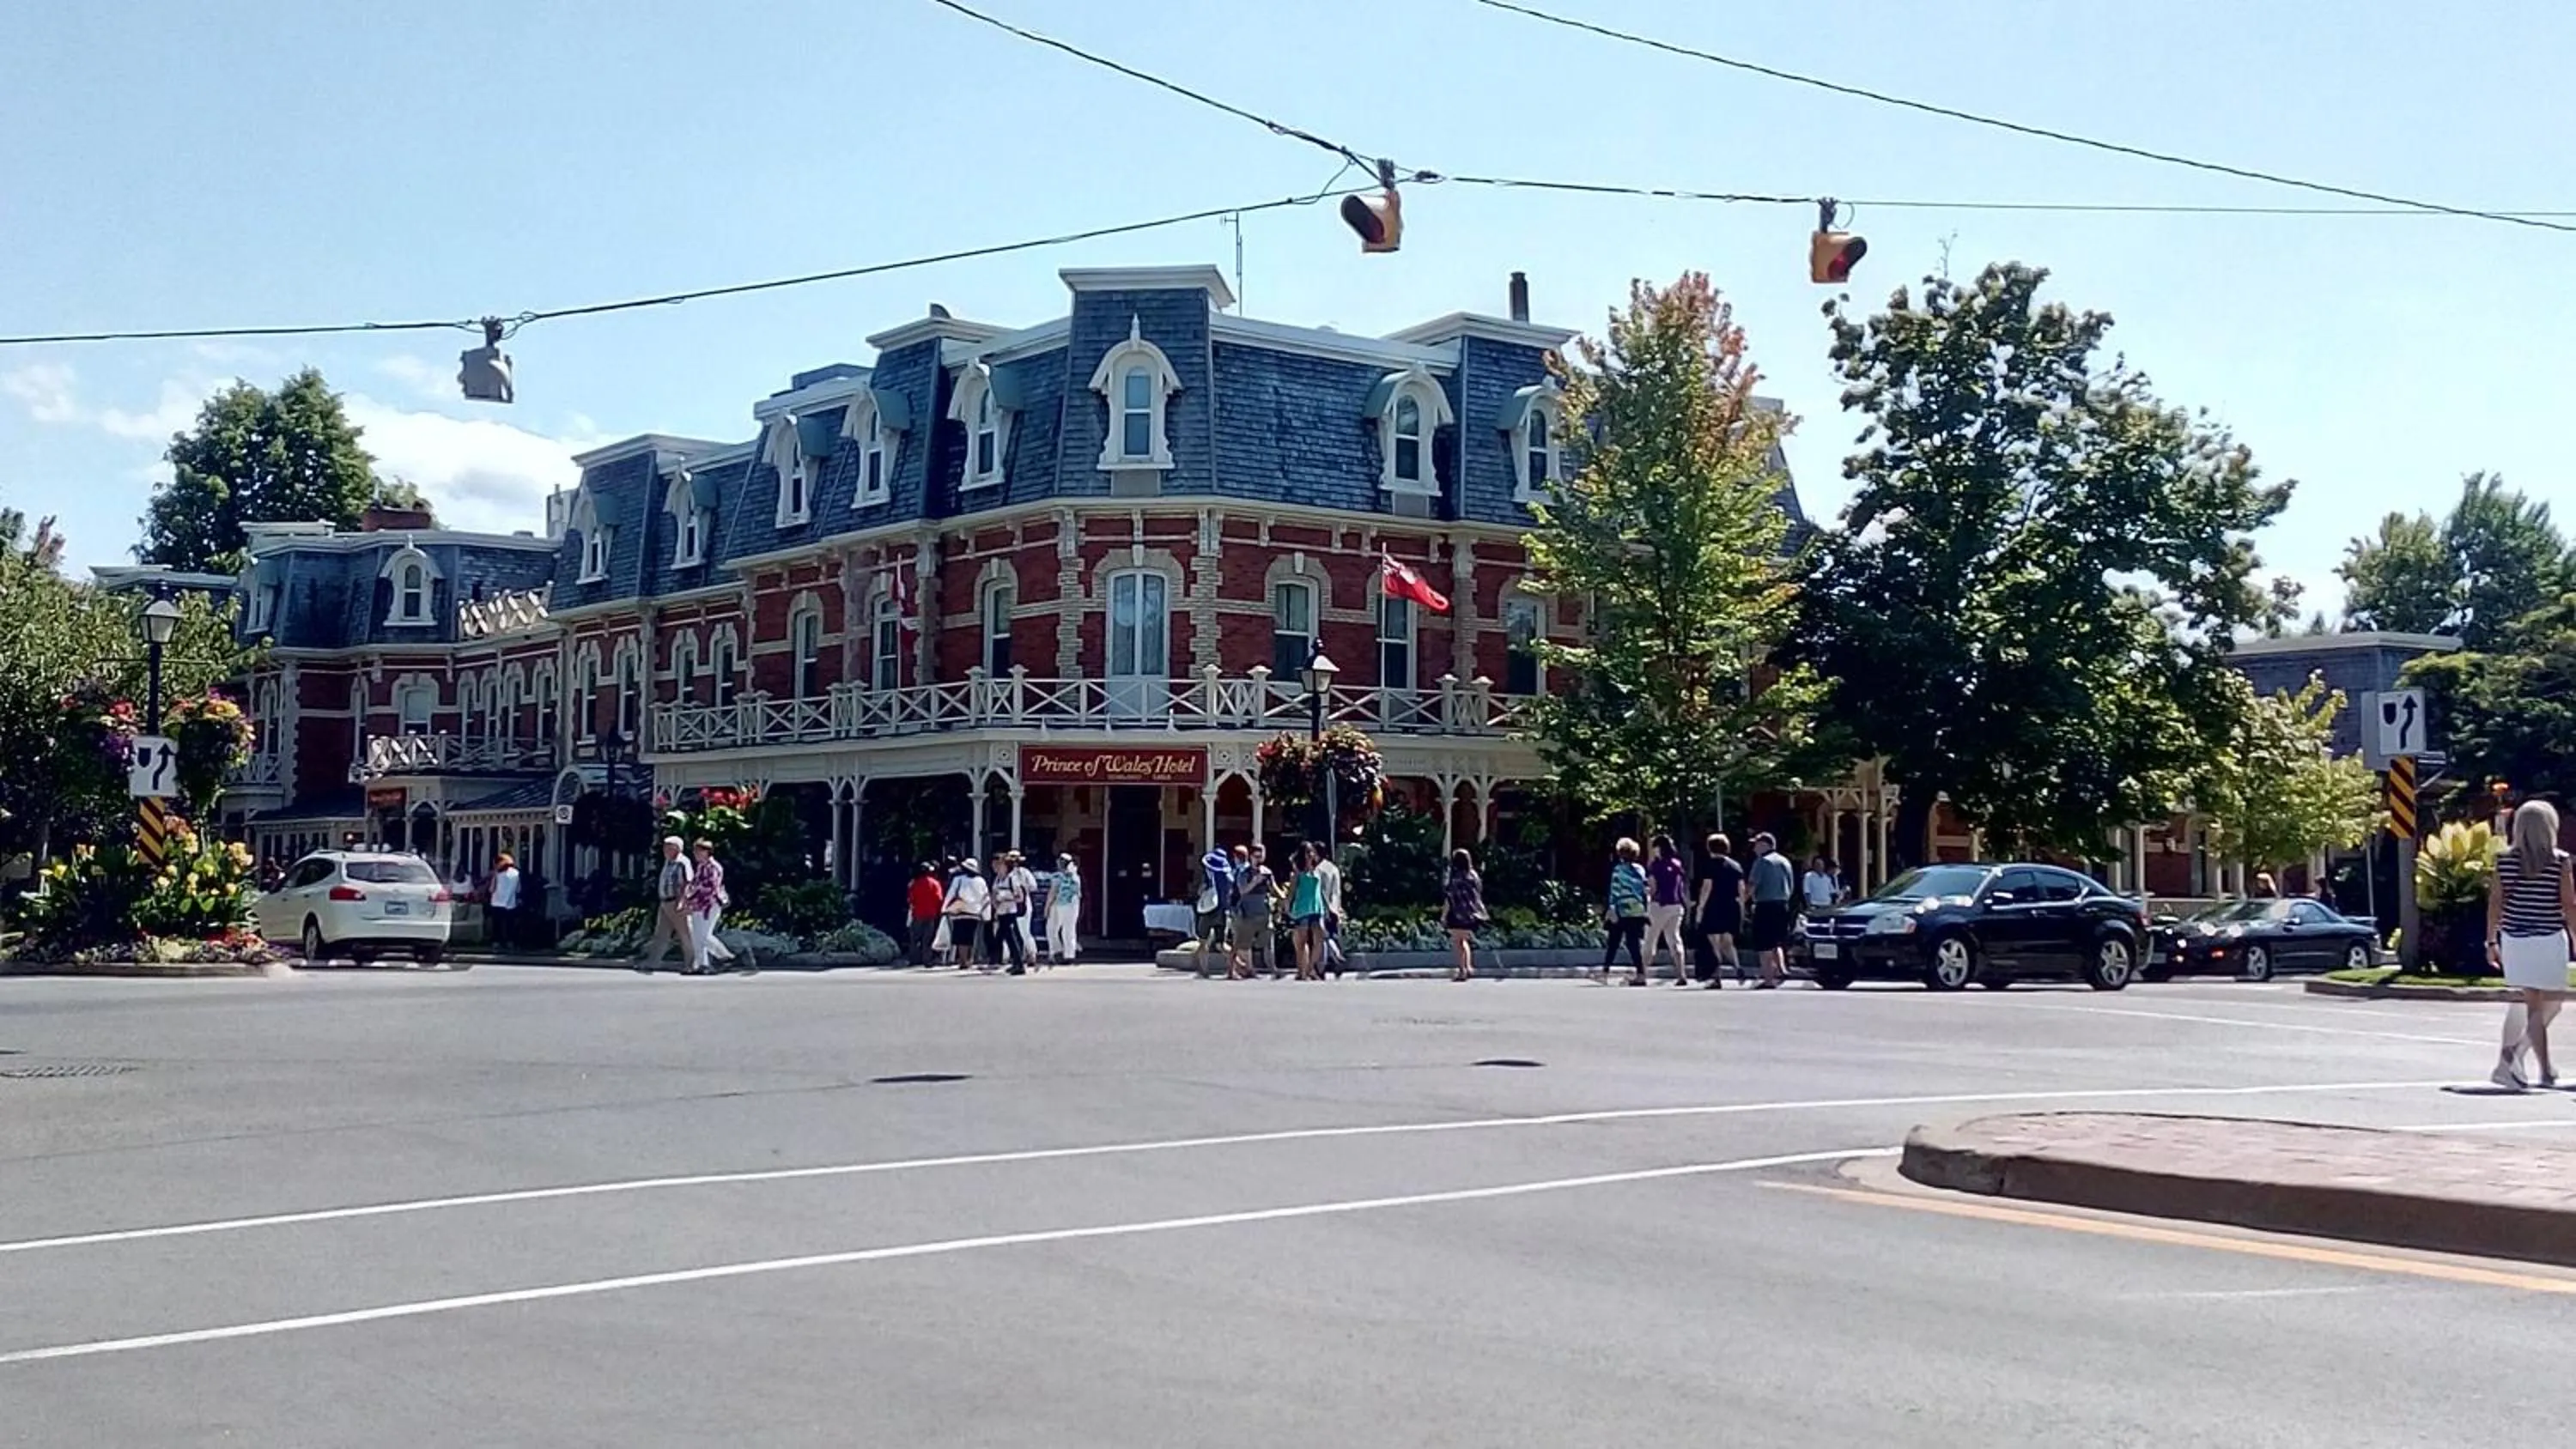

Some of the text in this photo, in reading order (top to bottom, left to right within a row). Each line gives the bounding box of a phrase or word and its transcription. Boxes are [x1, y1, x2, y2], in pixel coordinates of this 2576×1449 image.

[1031, 755, 1195, 777] Prince of Wales Hotel
